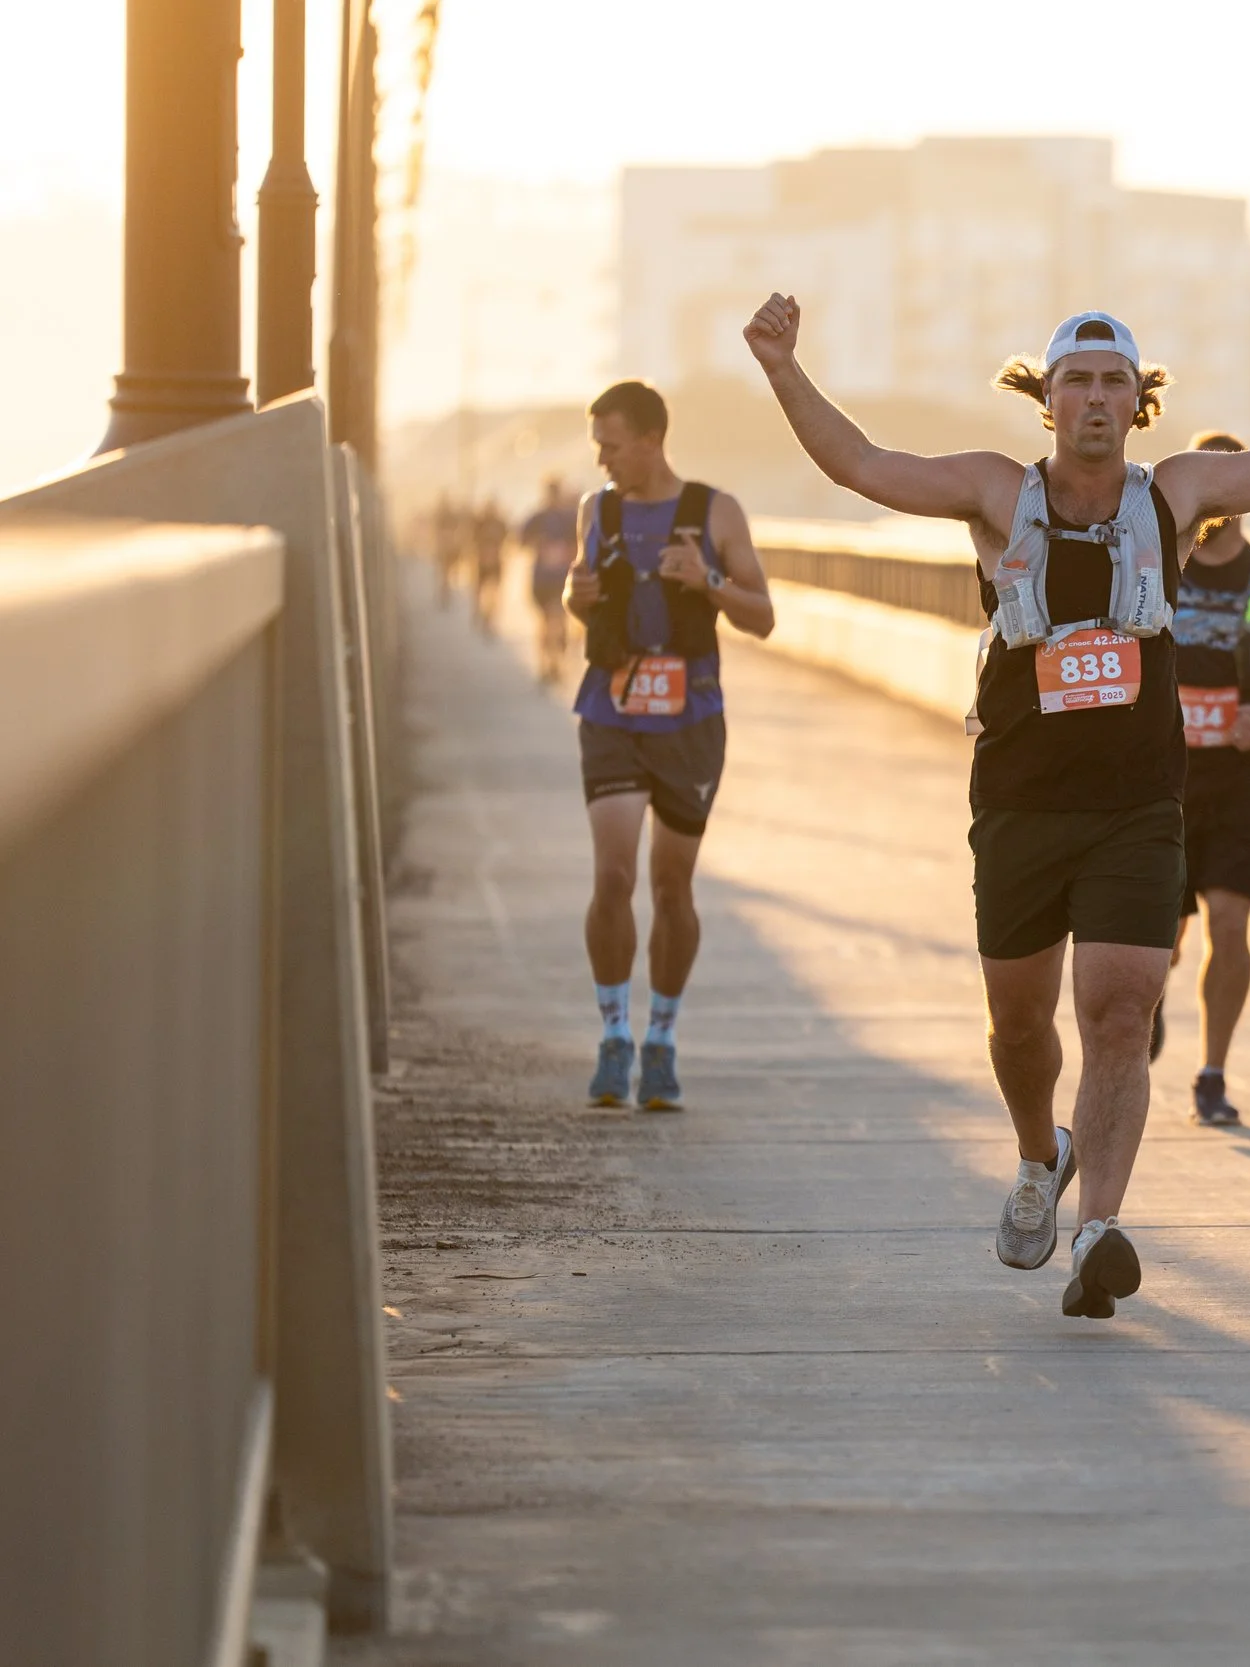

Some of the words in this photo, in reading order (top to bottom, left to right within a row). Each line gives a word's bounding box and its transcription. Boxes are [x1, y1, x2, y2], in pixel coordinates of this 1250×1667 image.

[1134, 576, 1148, 627] NATHAN
[1060, 651, 1122, 684] 838
[1101, 691, 1124, 700] 2025
